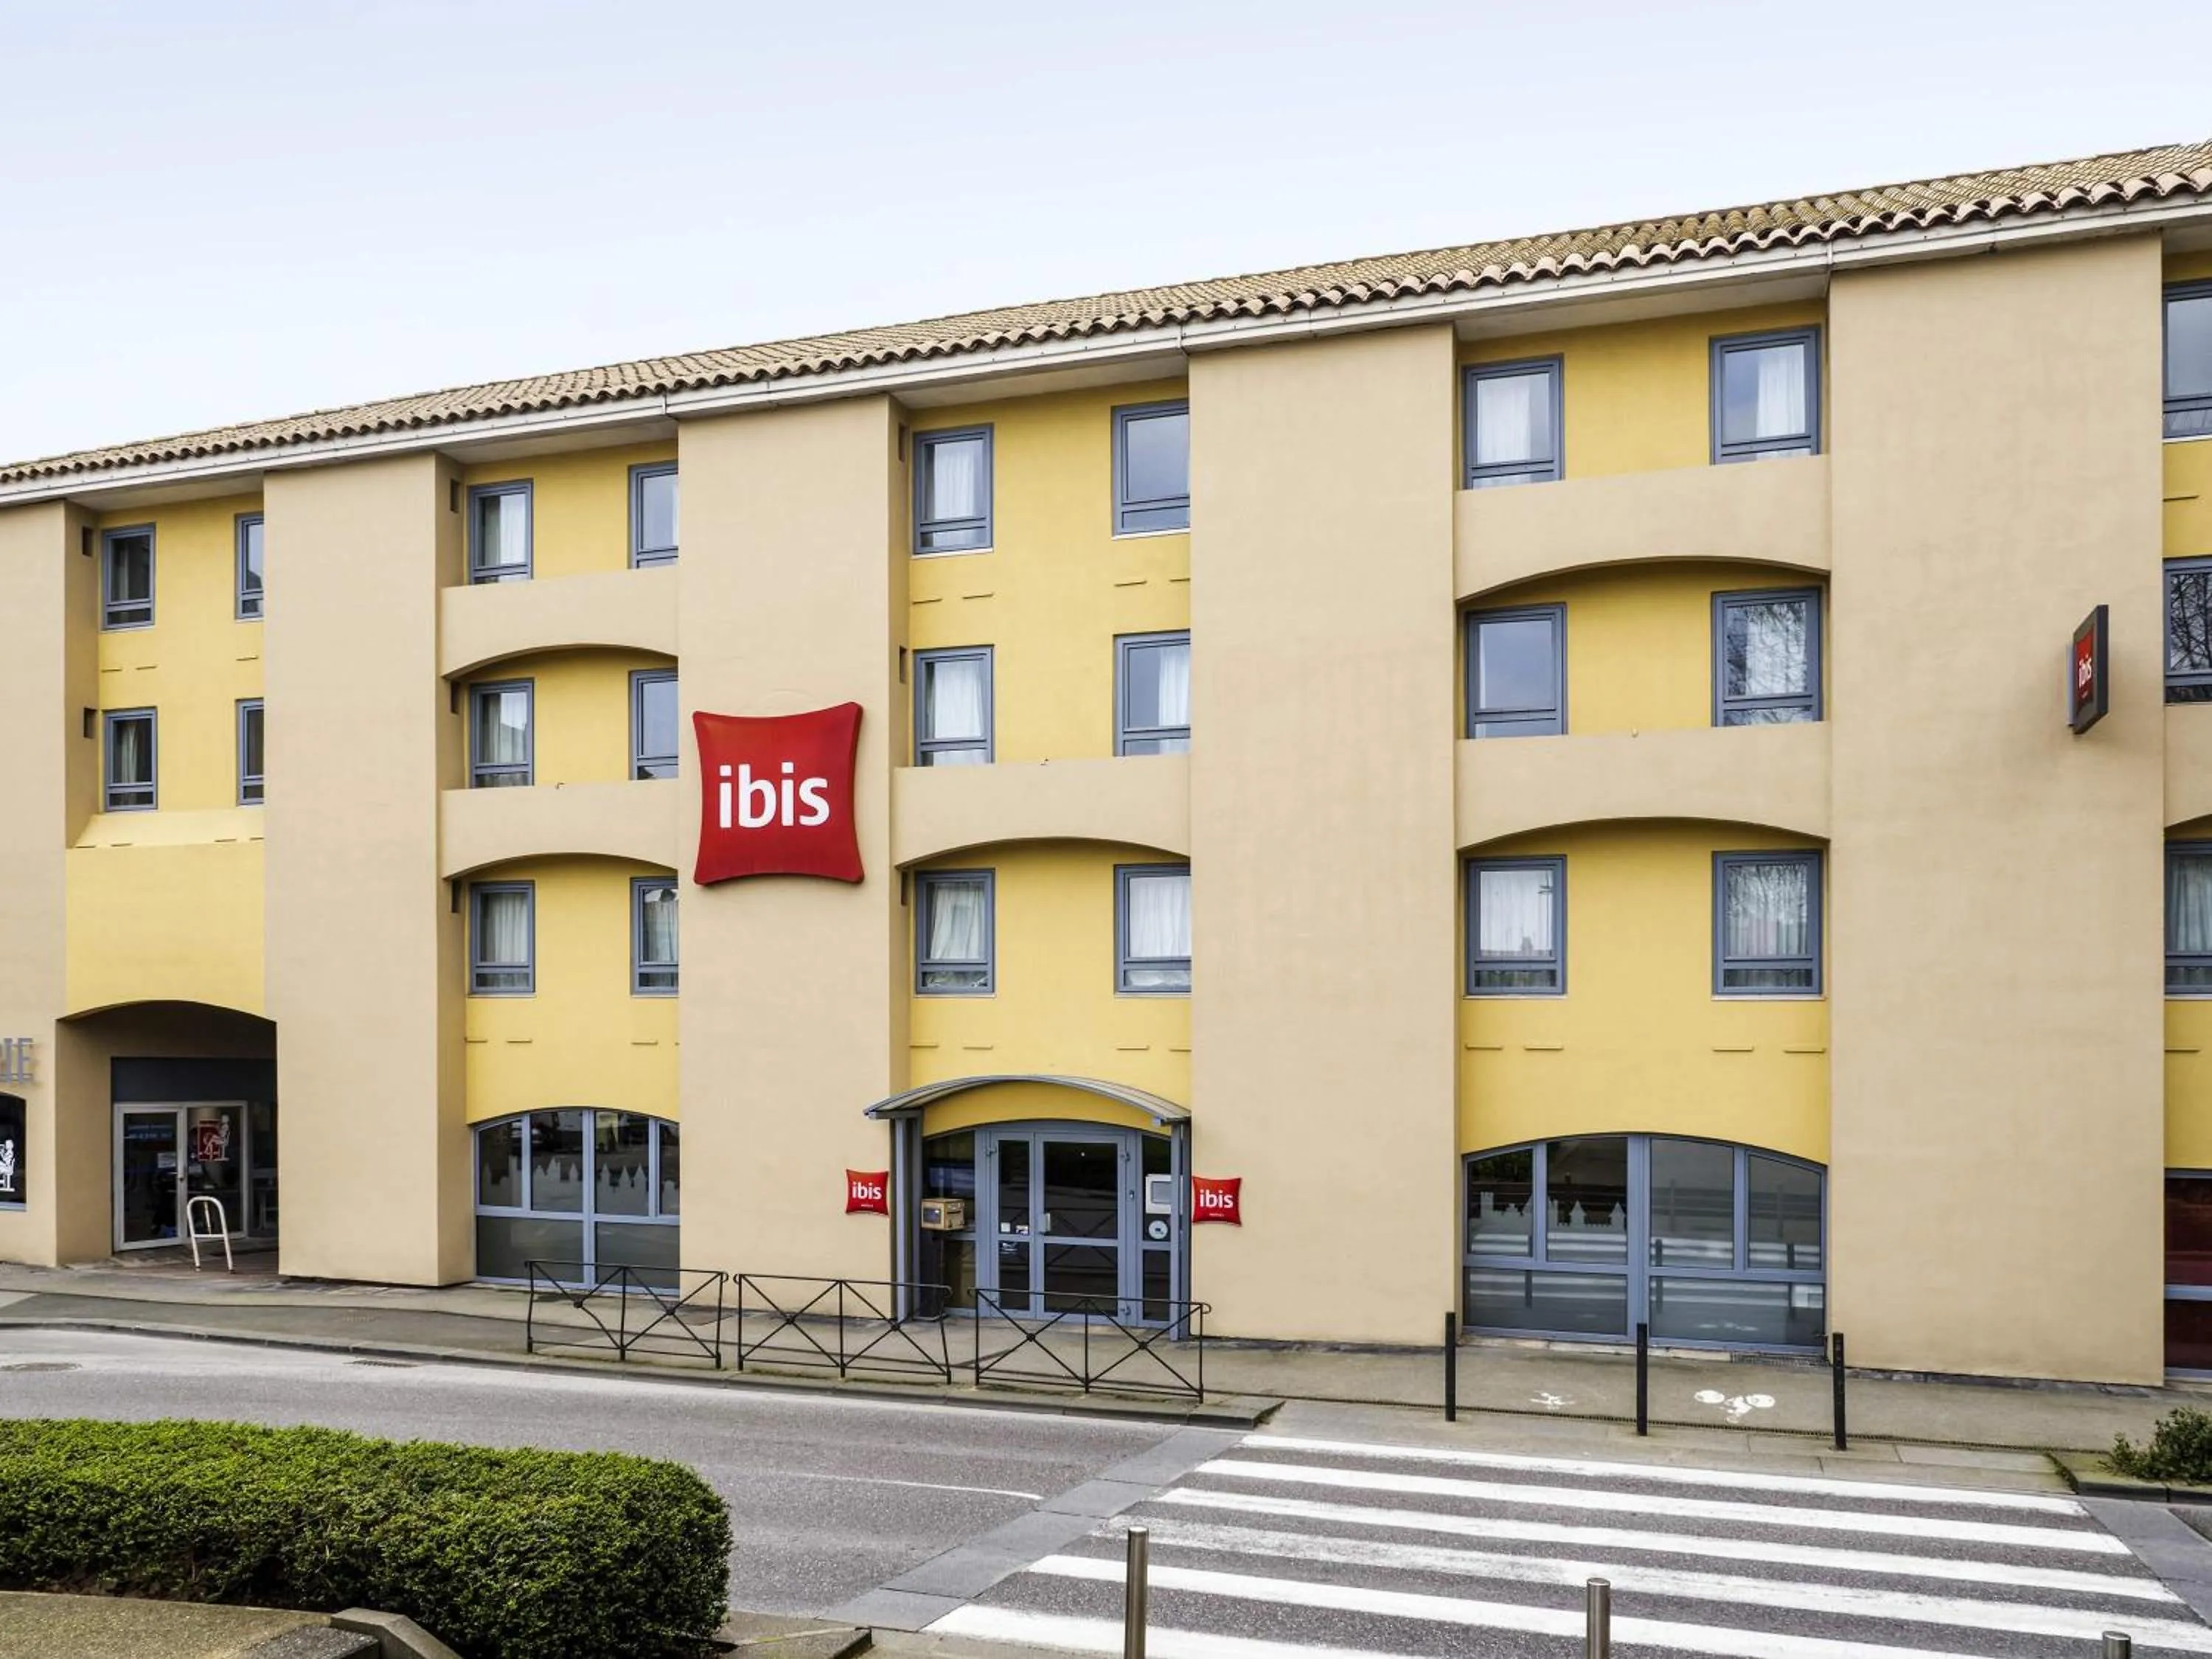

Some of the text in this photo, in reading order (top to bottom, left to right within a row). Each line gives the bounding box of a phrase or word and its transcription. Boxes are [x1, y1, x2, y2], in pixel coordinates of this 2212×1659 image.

[2079, 654, 2092, 688] ibis
[719, 762, 830, 828] ibis
[0, 1037, 33, 1084] IE
[852, 1181, 882, 1200] ibis
[1200, 1189, 1234, 1208] ibis
